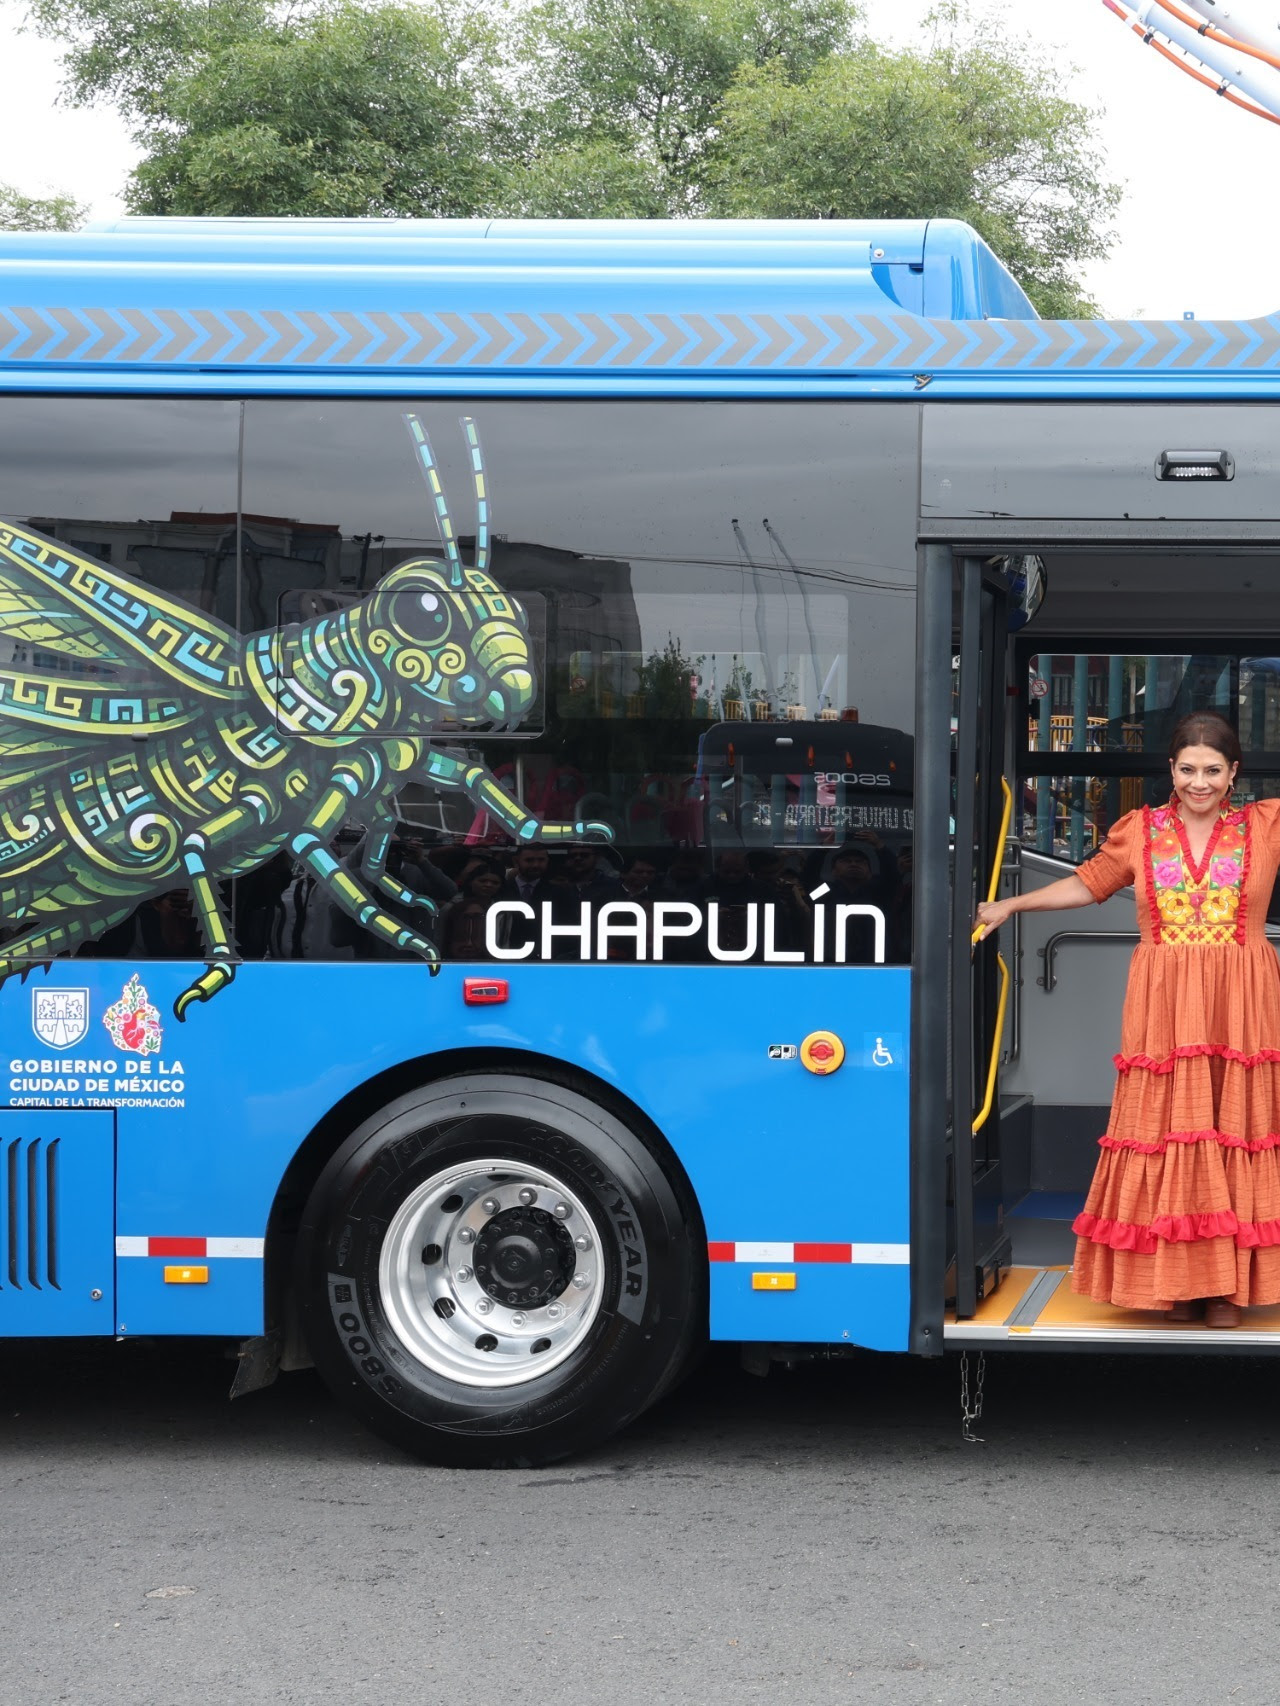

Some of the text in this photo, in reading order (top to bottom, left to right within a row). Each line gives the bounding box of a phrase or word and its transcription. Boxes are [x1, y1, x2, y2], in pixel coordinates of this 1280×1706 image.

[9, 1059, 185, 1075] GOBIERNO DE LA
[9, 1076, 185, 1093] CIUDAD DE MÉXICO
[9, 1096, 185, 1108] CAPITAL DE LA TRANSFORMACIÓN
